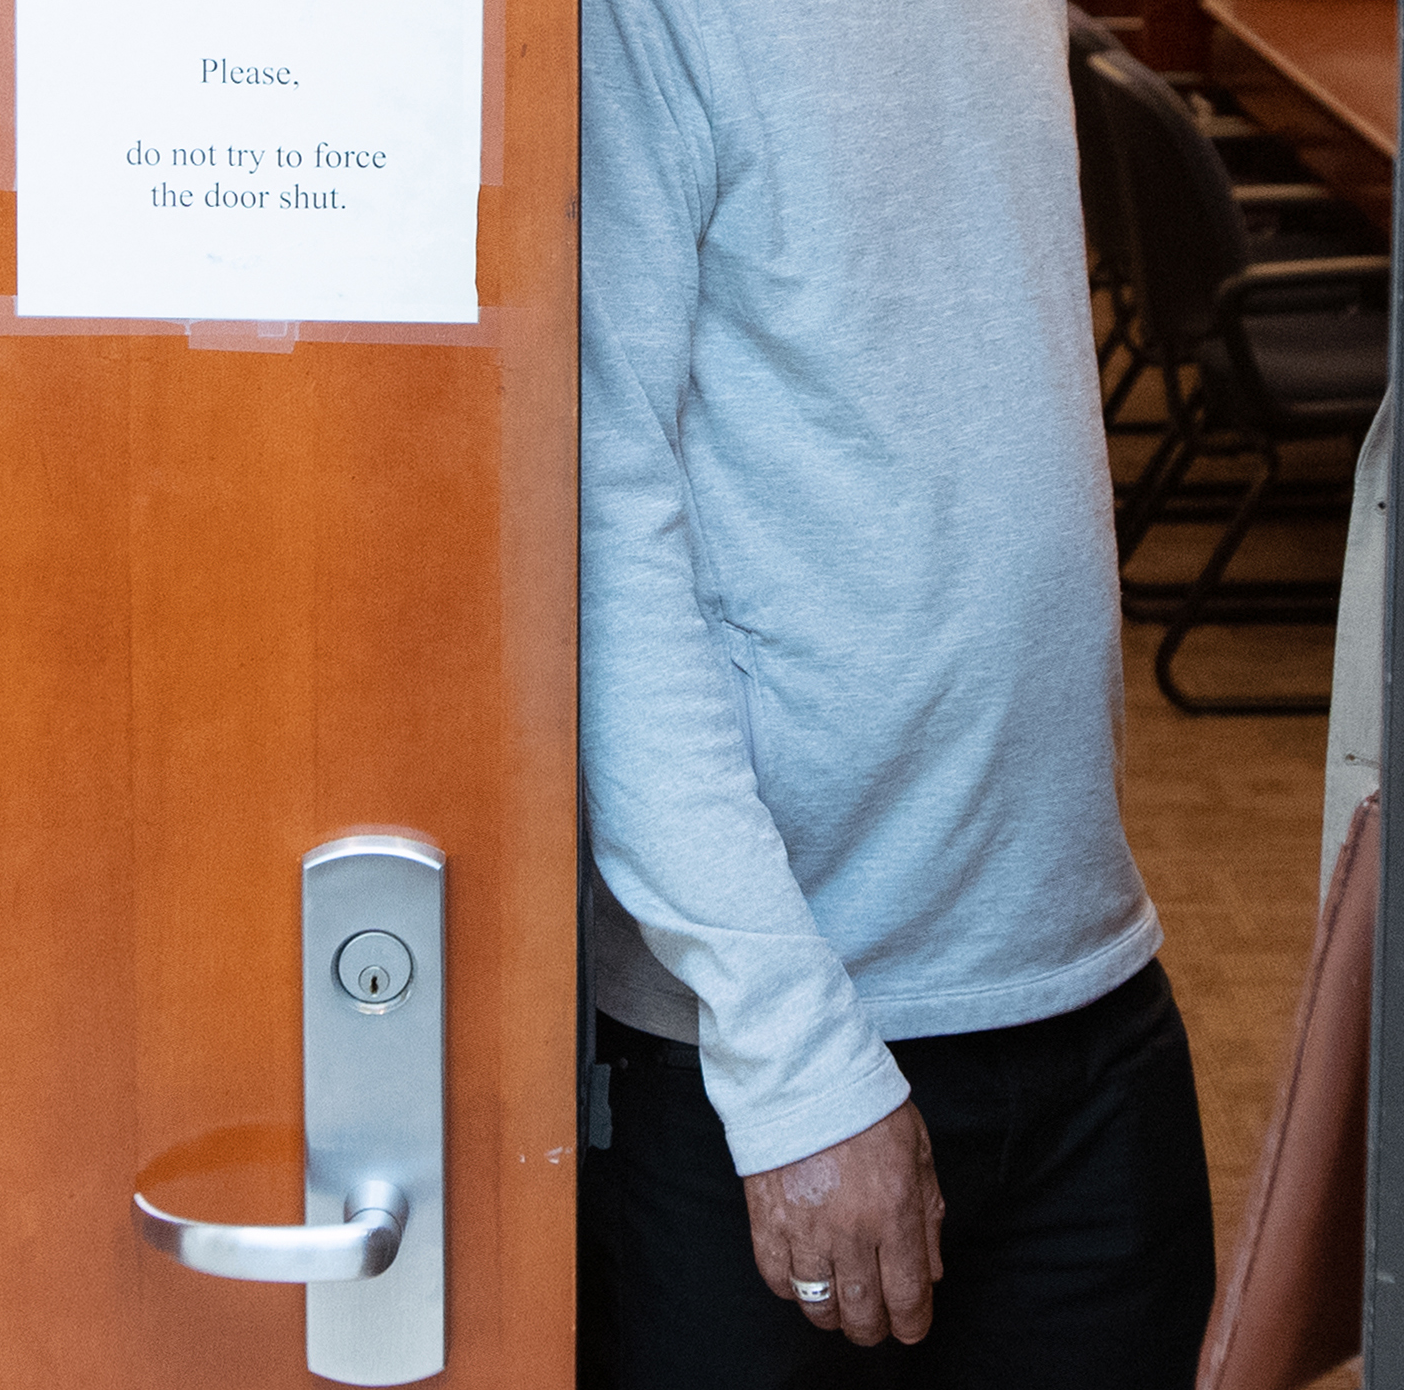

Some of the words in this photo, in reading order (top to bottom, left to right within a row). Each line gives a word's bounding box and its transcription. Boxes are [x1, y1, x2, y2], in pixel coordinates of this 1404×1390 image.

[200, 57, 300, 91] Please,
[126, 140, 161, 168] do
[172, 145, 217, 168] not
[226, 146, 266, 175] try
[276, 146, 303, 169] to
[315, 141, 388, 170] force
[151, 181, 195, 209] the
[204, 181, 270, 210] door
[279, 183, 347, 210] shut.
